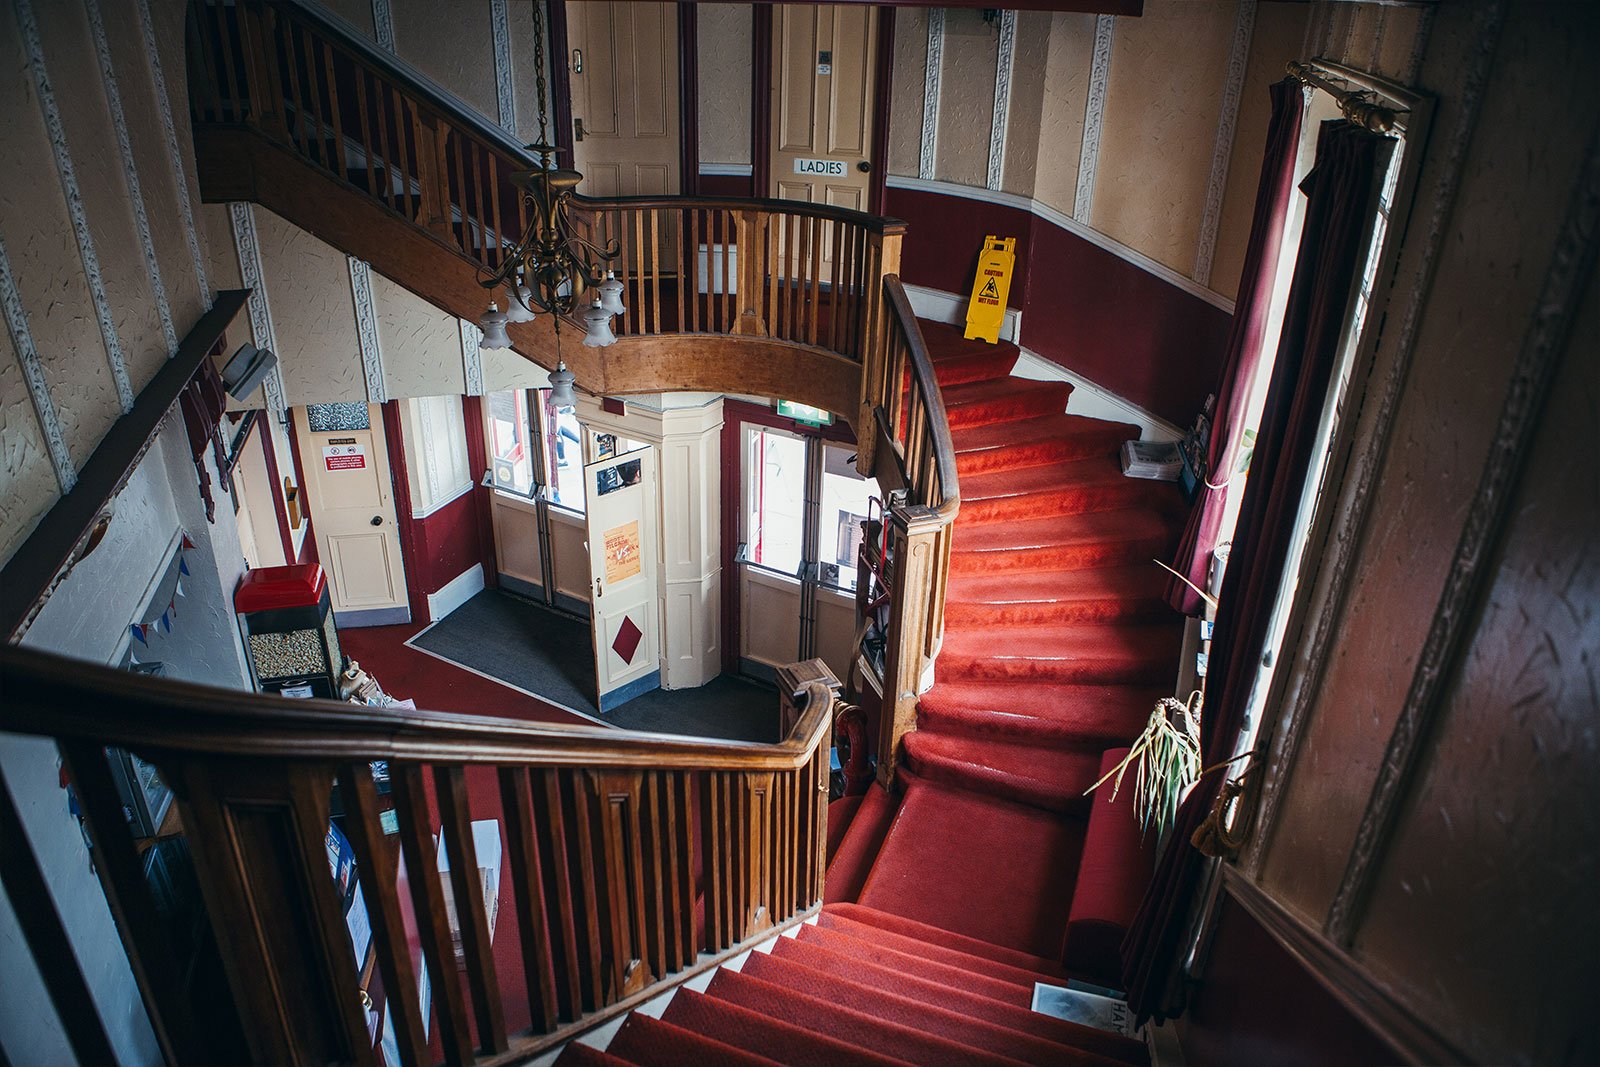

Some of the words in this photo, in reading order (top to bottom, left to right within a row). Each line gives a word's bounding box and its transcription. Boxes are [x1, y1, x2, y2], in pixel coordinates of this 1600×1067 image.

[800, 160, 842, 174] LADIES
[984, 269, 1004, 278] CAUTION
[978, 296, 987, 304] WET
[987, 298, 999, 306] FLOOR
